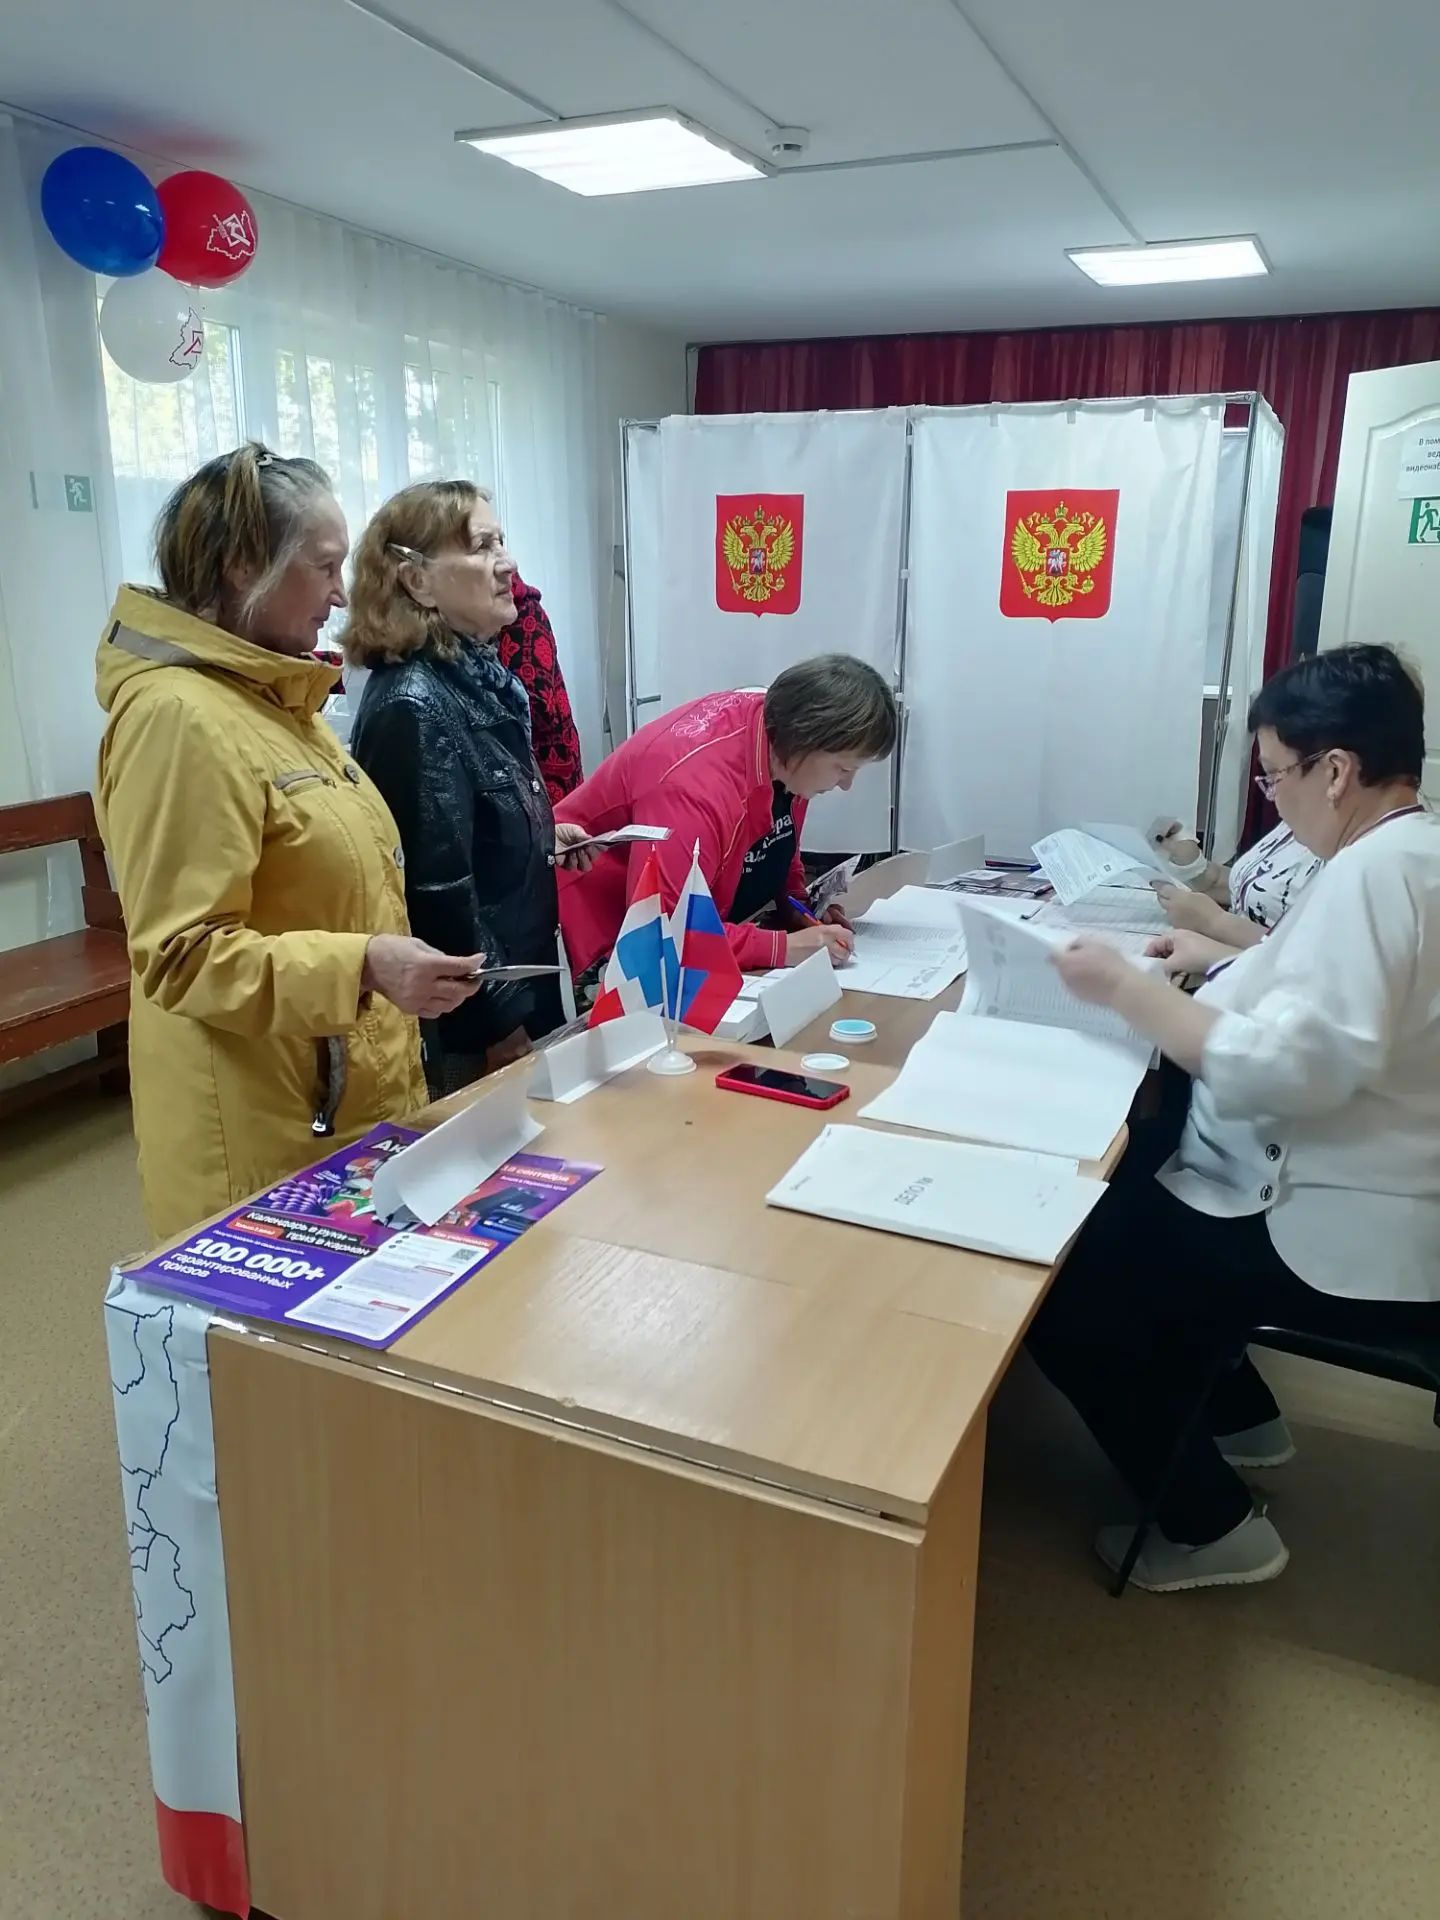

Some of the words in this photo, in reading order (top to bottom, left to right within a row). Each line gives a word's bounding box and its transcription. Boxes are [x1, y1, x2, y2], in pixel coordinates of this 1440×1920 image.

[247, 1211, 308, 1233] Календарь
[316, 1225, 348, 1242] руки
[185, 1238, 244, 1262] 100
[245, 1254, 326, 1281] 000+
[286, 1232, 315, 1247] приз
[322, 1239, 370, 1257] карман
[159, 1260, 210, 1278] призов
[170, 1252, 295, 1290] гарантированных
